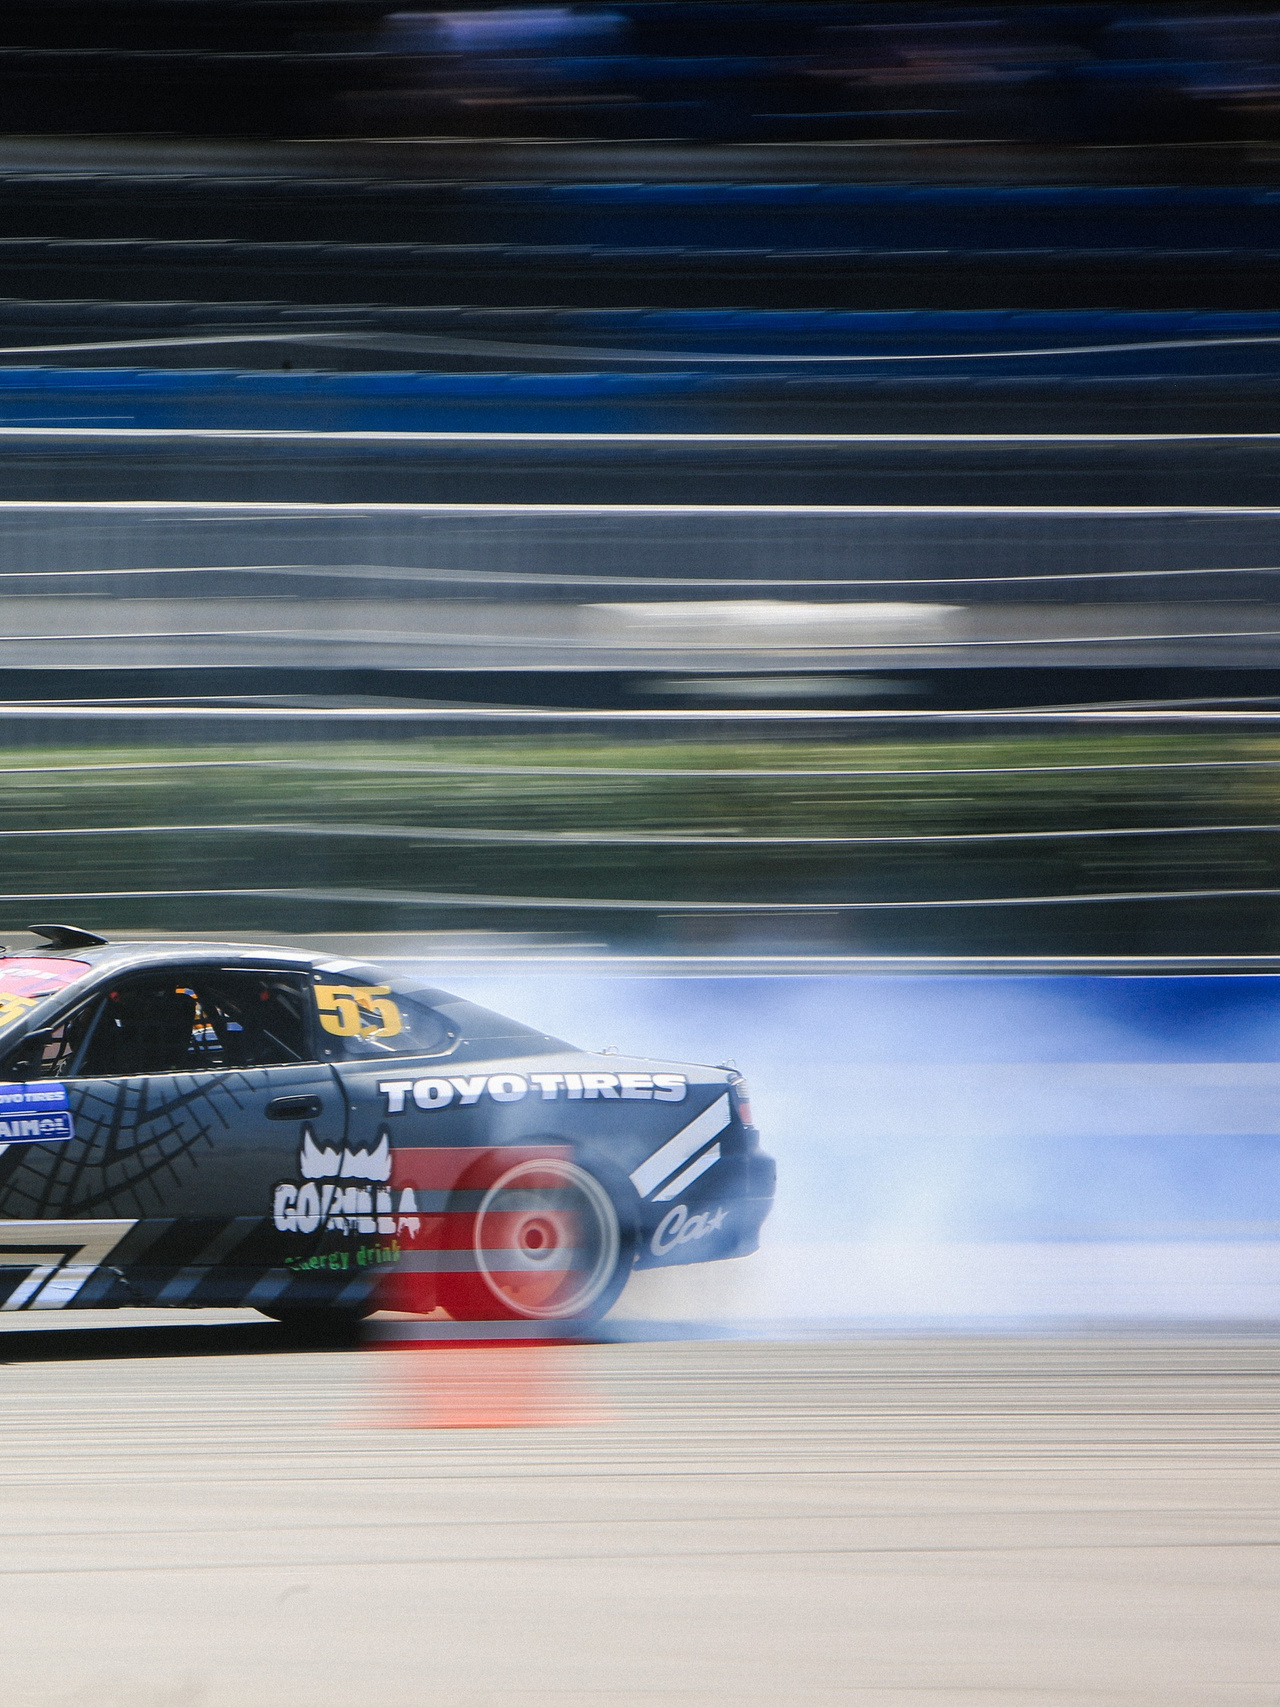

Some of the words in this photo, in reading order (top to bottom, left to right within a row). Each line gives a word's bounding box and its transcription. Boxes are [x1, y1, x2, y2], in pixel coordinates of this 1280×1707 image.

[314, 984, 403, 1037] 55
[24, 1091, 66, 1103] TIRES
[379, 1074, 528, 1113] TOYO
[530, 1073, 688, 1102] TIRES
